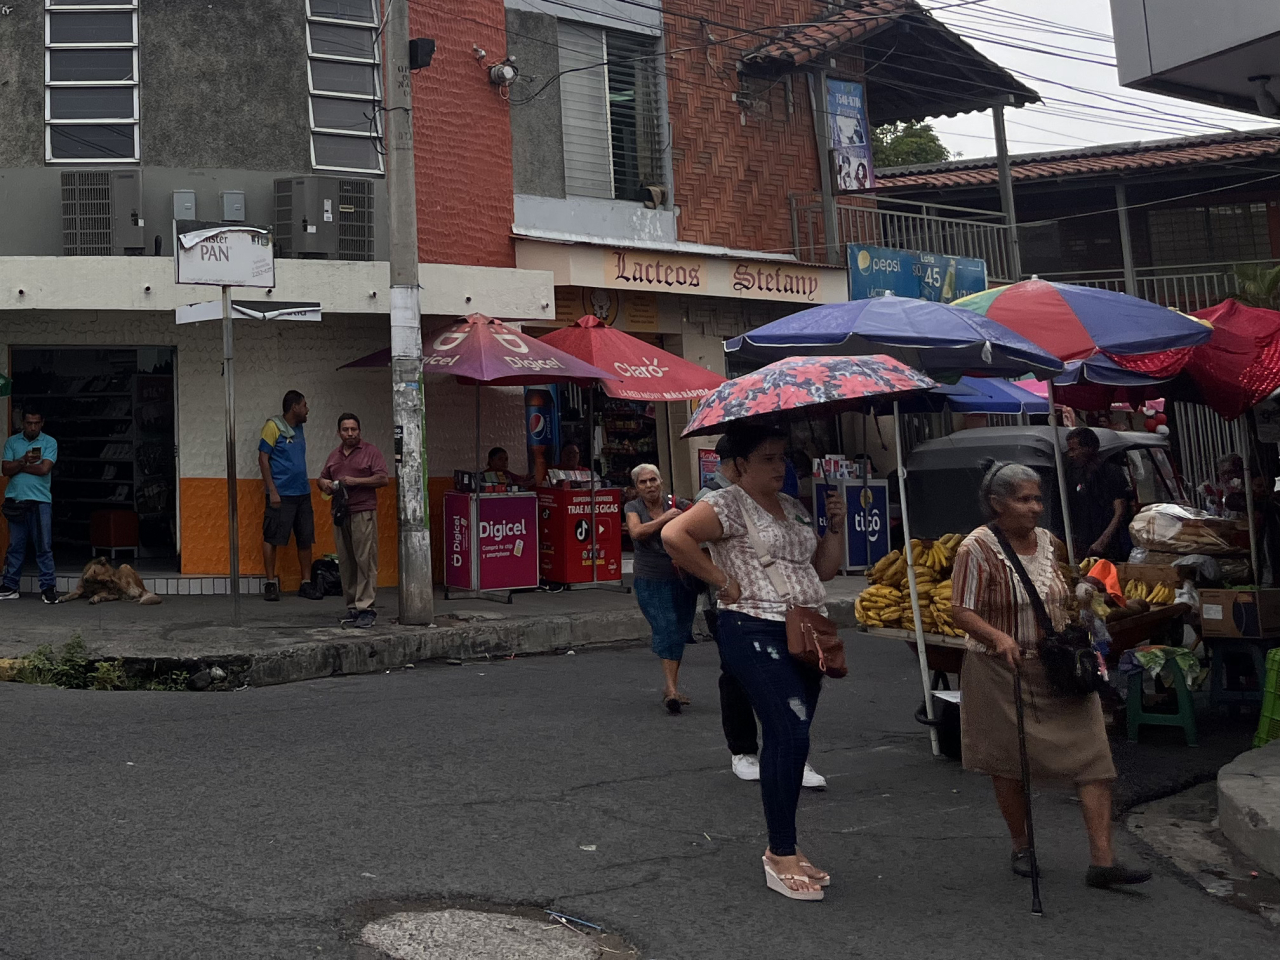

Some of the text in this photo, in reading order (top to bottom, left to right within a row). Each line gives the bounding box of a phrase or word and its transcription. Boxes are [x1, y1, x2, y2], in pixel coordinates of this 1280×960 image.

[200, 244, 230, 262] PAN
[872, 257, 902, 275] pepsi
[613, 251, 819, 302] Lacteos Stefany
[503, 355, 566, 372] Digicel
[613, 357, 665, 379] Claro
[618, 389, 628, 397] LA
[627, 390, 641, 398] RED
[662, 390, 682, 399] MÁS
[567, 505, 584, 514] TRAE
[599, 503, 619, 513] GIGAS
[453, 515, 462, 552] Digicel
[479, 518, 527, 542] Digicel
